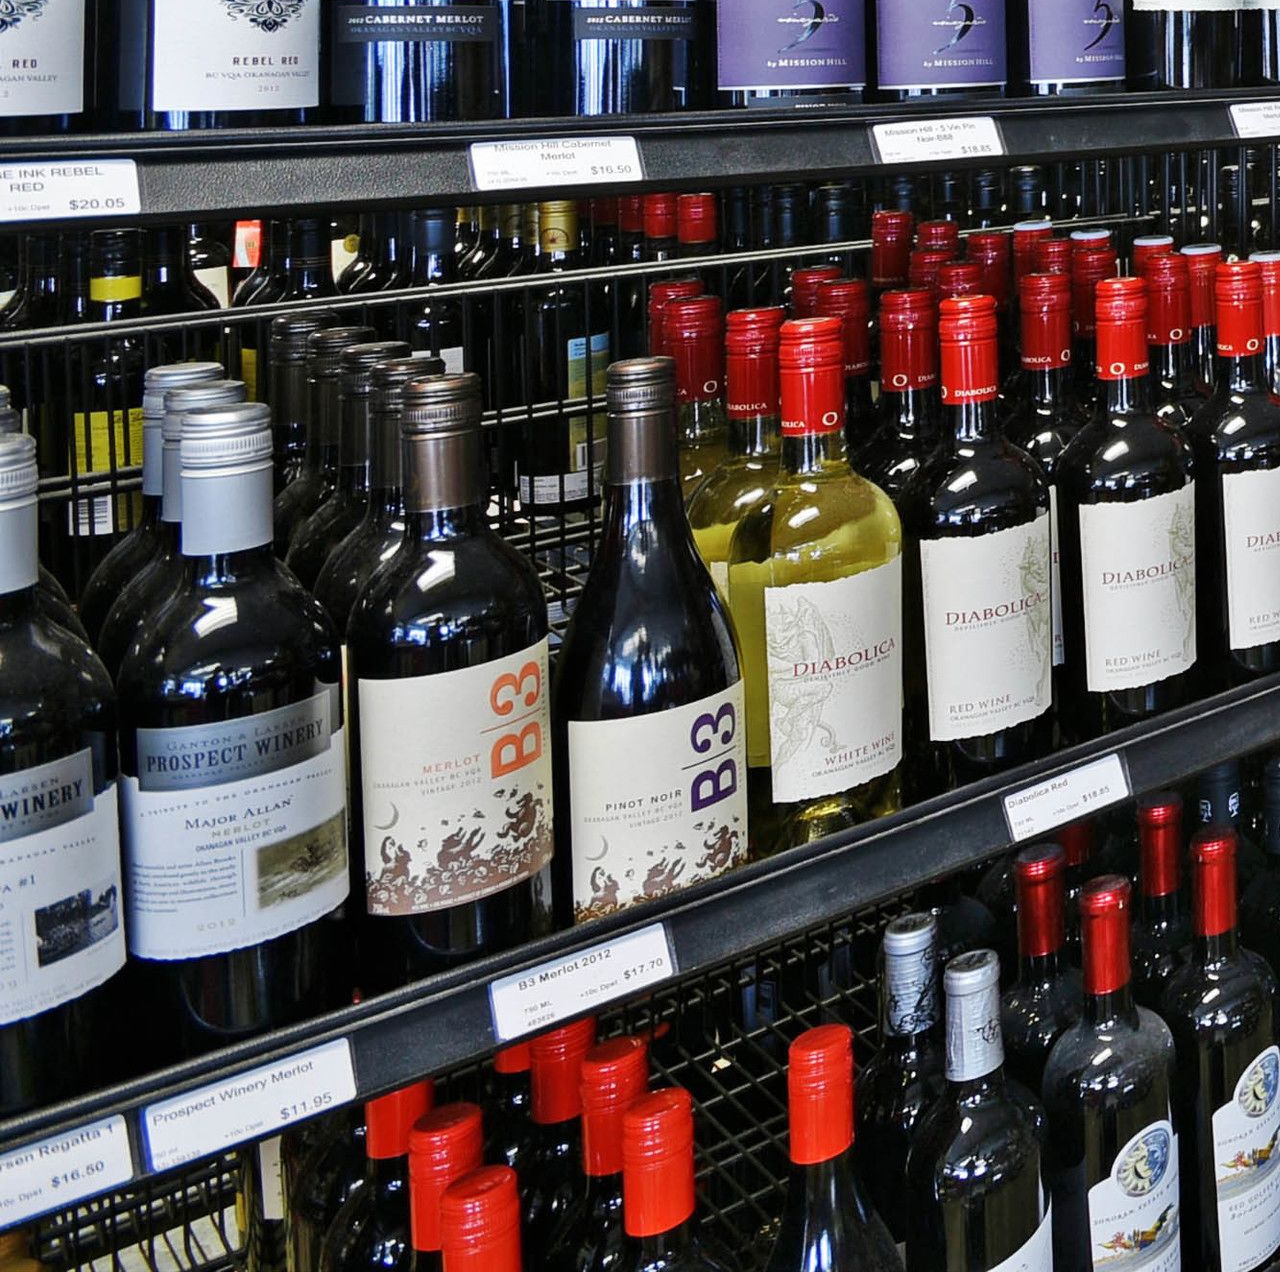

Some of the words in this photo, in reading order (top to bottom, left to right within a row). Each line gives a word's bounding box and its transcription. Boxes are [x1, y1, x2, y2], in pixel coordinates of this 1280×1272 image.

[365, 15, 432, 24] CABERNET
[436, 15, 484, 24] MERLOT
[605, 15, 662, 23] CABERNET
[12, 59, 38, 69] RED
[233, 56, 274, 67] REBEL
[282, 56, 299, 66] RED
[778, 58, 824, 67] MISSION
[826, 58, 848, 66] HILL
[934, 59, 974, 67] MISSION
[884, 128, 916, 137] Mission
[541, 151, 575, 161] Merlot
[19, 168, 45, 178] INK
[50, 167, 104, 177] REBEL
[591, 164, 631, 176] $16.50
[10, 182, 44, 192] RED
[69, 198, 125, 211] $20.05
[1102, 556, 1193, 586] DIABOLICA
[945, 592, 1043, 626] DIABOLICA
[1249, 614, 1271, 624] RED
[792, 637, 896, 679] DIABOLICA
[1104, 655, 1130, 668] RED
[1133, 648, 1161, 664] WINE
[949, 702, 974, 715] RED
[978, 693, 1012, 710] WINE
[147, 745, 248, 773] PROSPECT
[254, 719, 324, 757] WINERY
[166, 736, 234, 753] GANTON
[824, 742, 870, 767] WHITE
[871, 732, 897, 754] WINE
[423, 754, 481, 774] MERLOT
[413, 776, 446, 787] VALLEY
[421, 784, 457, 796] VINTAGE
[2, 779, 82, 820] WINERY
[605, 798, 644, 811] PINOT
[650, 789, 683, 803] NOIR
[1008, 787, 1049, 809] Diabolica
[1051, 779, 1069, 791] Red
[185, 813, 237, 831] MAJOR
[244, 797, 291, 819] ALLAN
[211, 818, 270, 839] MERLOT
[195, 839, 233, 852] OKANAGAN
[234, 833, 260, 845] VALLEY
[19, 874, 35, 887] #1
[518, 976, 535, 991] B3
[539, 962, 579, 985] Merlot
[581, 949, 612, 968] 2012
[623, 958, 664, 980] $17.70
[153, 1097, 215, 1125] Prospect
[219, 1079, 267, 1107] Winery
[271, 1062, 314, 1088] Merlot
[280, 1092, 332, 1120] $11.95
[38, 1129, 98, 1159] Regatta
[51, 1160, 104, 1188] $16.50
